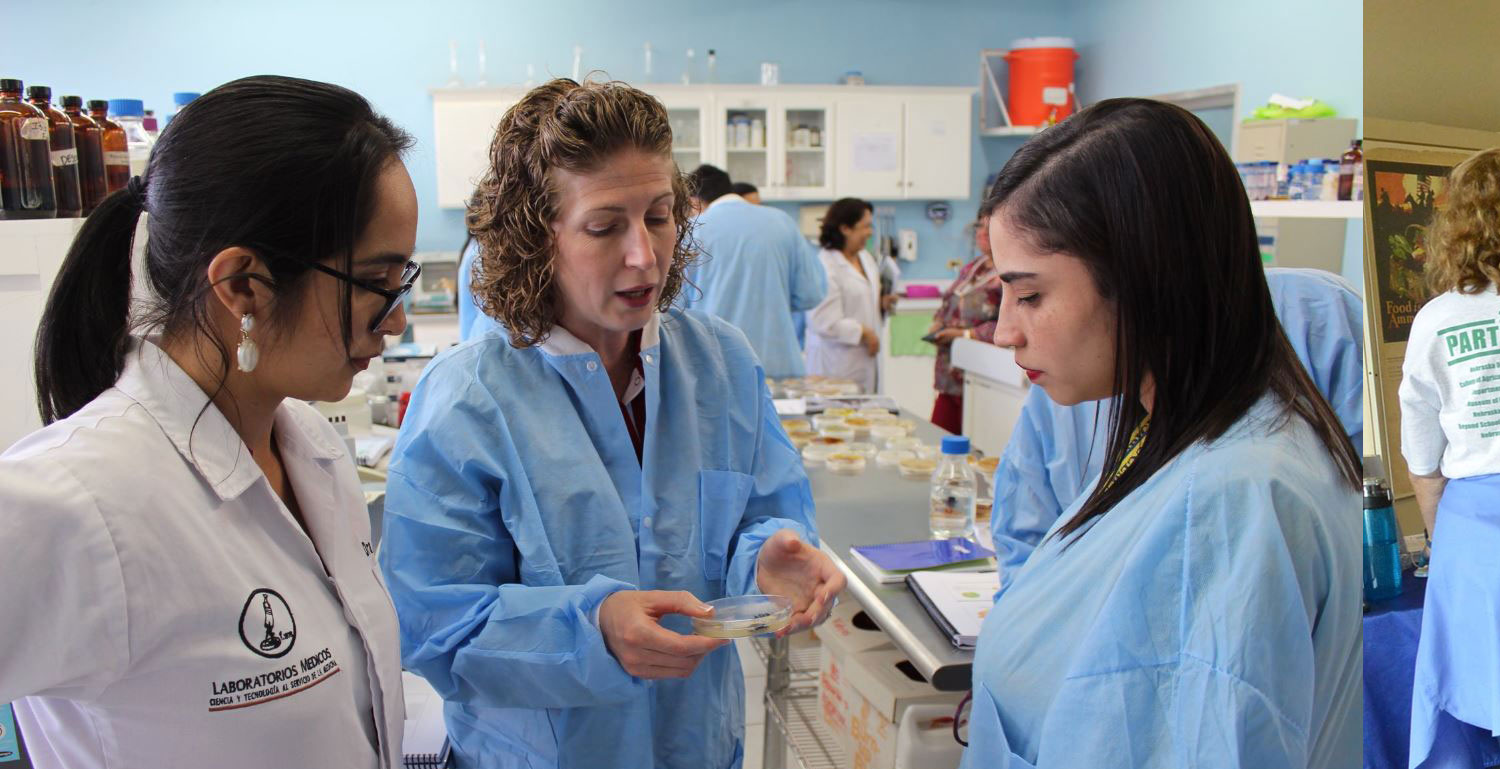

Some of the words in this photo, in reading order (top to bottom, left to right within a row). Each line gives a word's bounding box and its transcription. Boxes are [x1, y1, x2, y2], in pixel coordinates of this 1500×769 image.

[1386, 300, 1412, 314] Food
[212, 664, 299, 696] LABORATORIOS
[300, 647, 332, 673] MEDICOS
[209, 695, 234, 706] CIENCIA
[236, 694, 241, 702] Y
